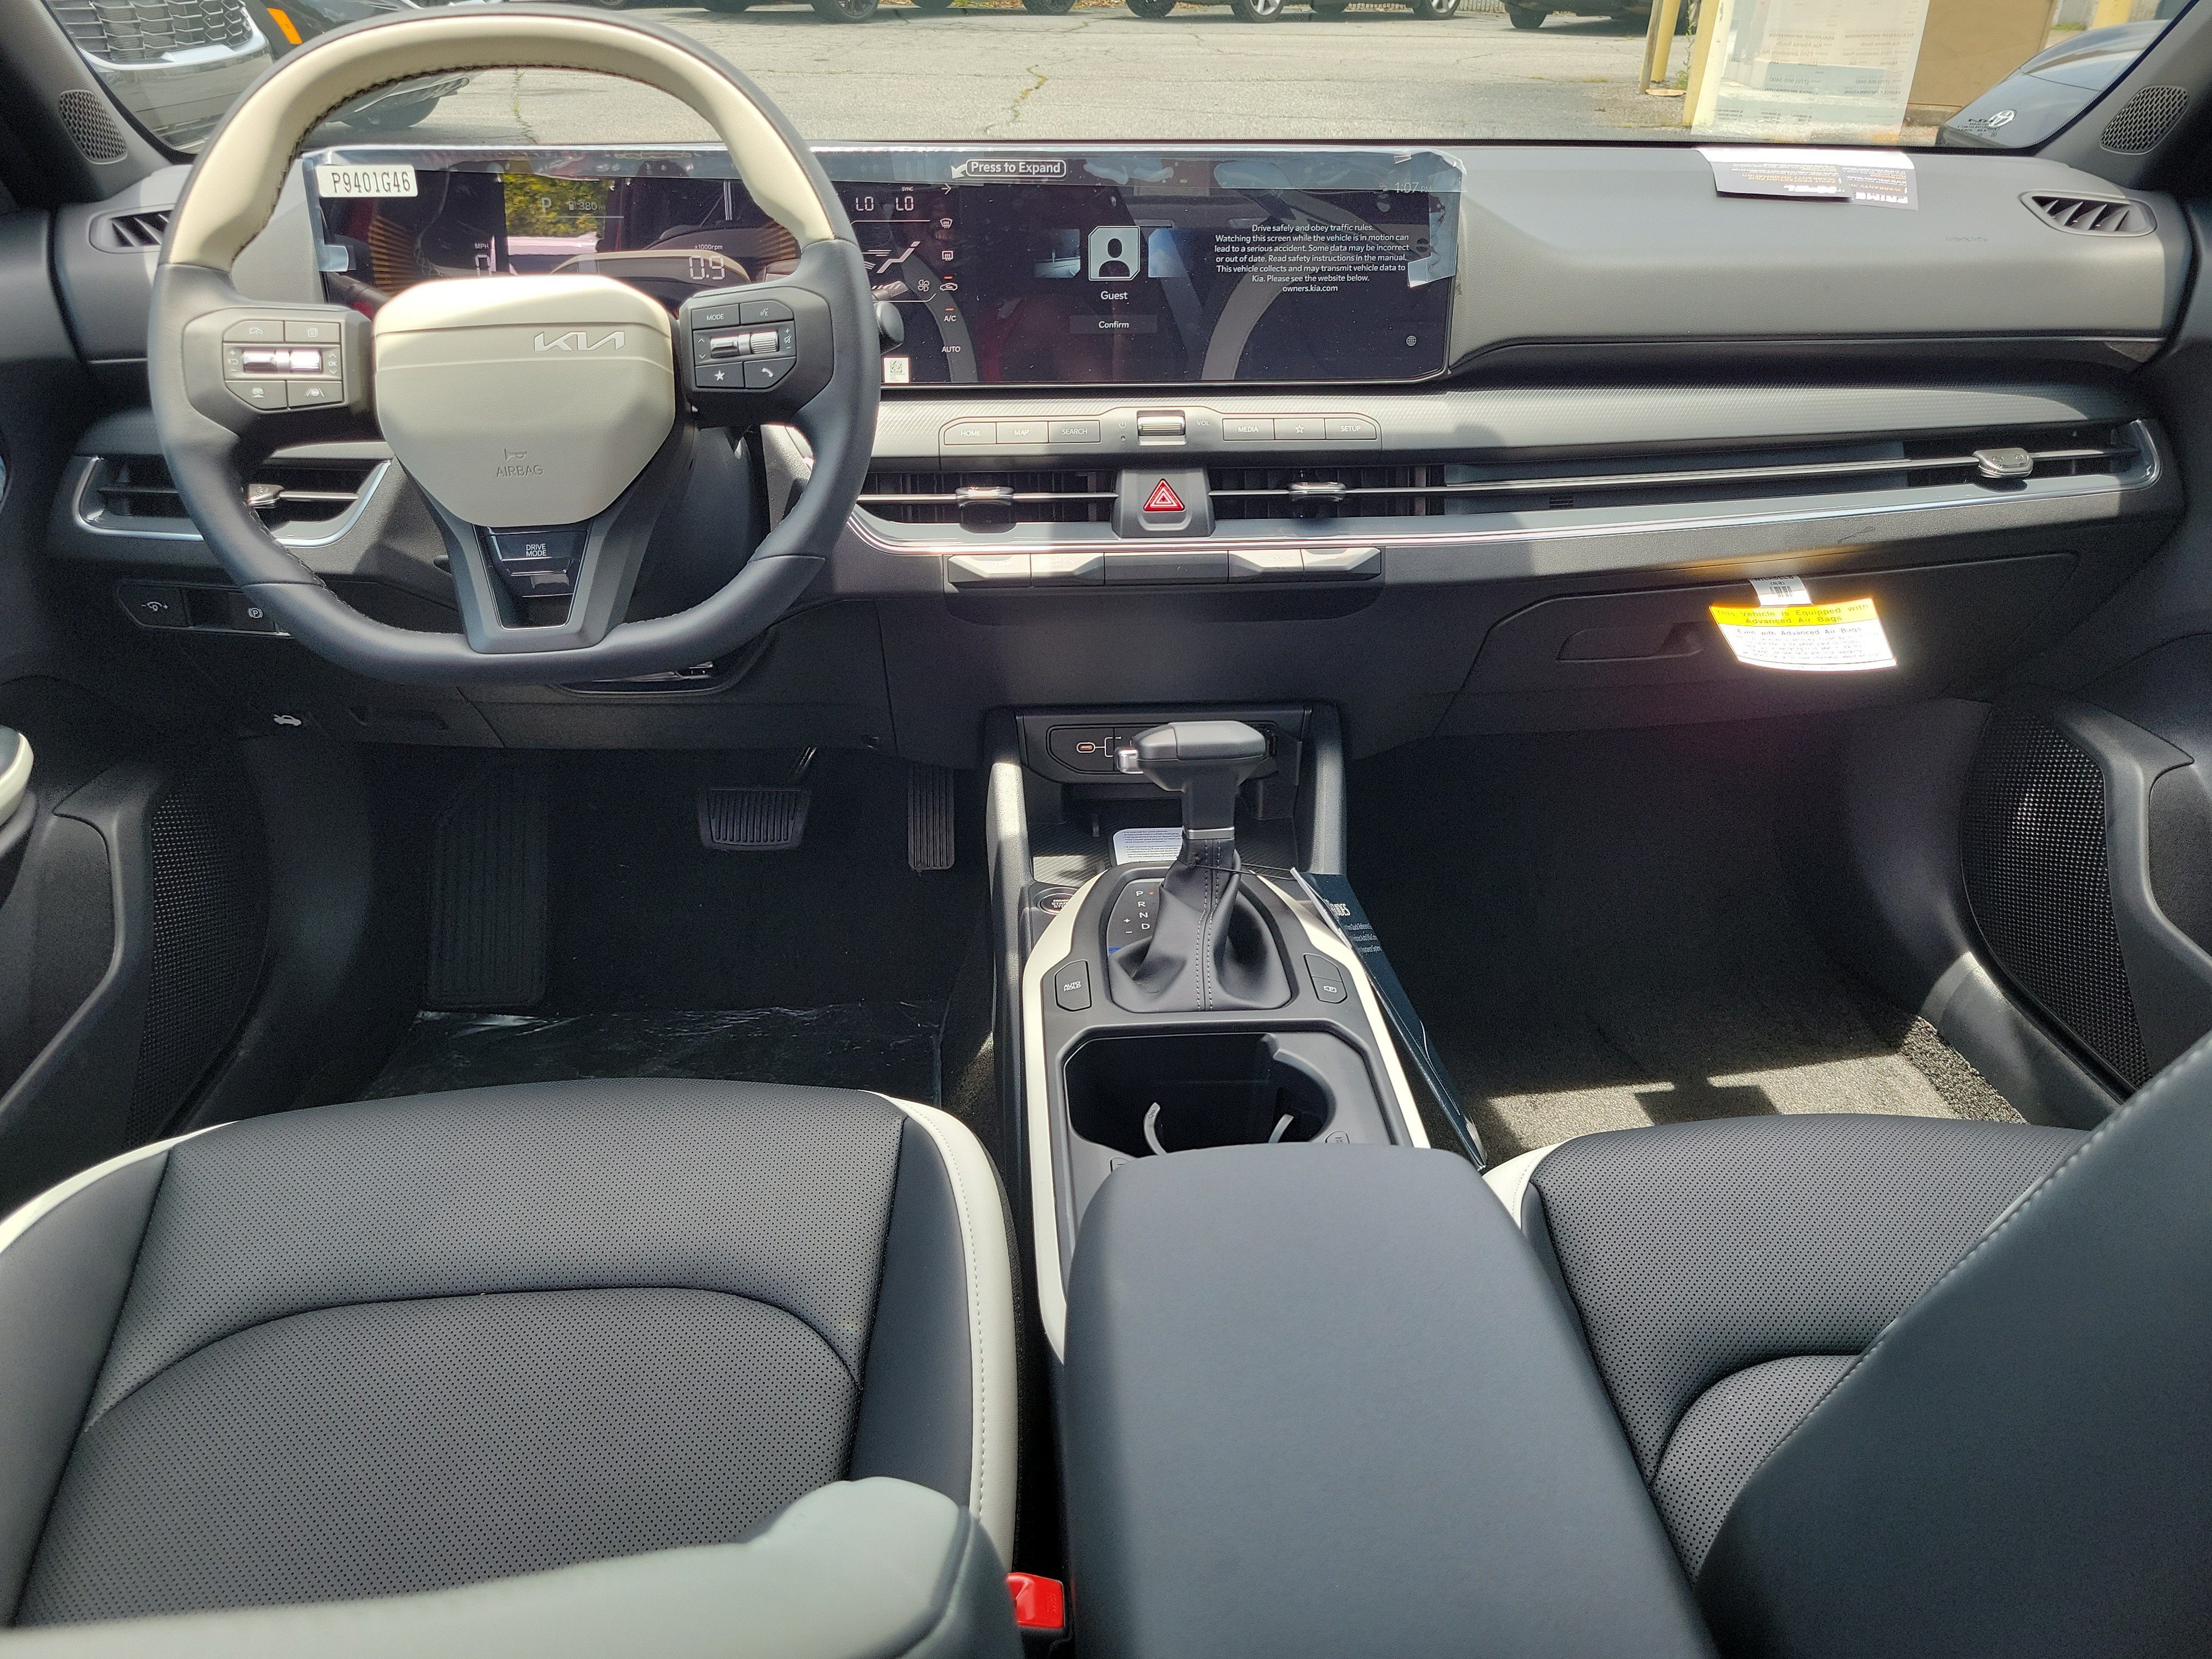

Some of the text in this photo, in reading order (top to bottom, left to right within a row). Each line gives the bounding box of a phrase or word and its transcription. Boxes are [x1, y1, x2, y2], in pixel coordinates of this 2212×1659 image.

[970, 161, 1060, 175] Press to Expand
[331, 171, 411, 195] P9401G46
[1394, 182, 1419, 194] 1:07
[1252, 223, 1374, 234] Drive safely and obey traffic rules.
[1215, 234, 1251, 244] Watching
[1252, 234, 1266, 242] this
[1292, 234, 1312, 242] while
[1313, 234, 1325, 242] the
[1326, 234, 1352, 242] vehicle
[1353, 234, 1359, 242] is
[1360, 234, 1368, 242] in
[1368, 234, 1394, 242] motion
[1214, 245, 1231, 253] lead
[1231, 245, 1240, 253] to
[1246, 245, 1273, 253] serious
[1274, 244, 1307, 252] accident.
[1308, 244, 1329, 252] Some
[1329, 244, 1347, 252] data
[1347, 246, 1365, 254] may
[1365, 244, 1375, 252] be
[1376, 244, 1410, 252] incorrect
[1224, 255, 1239, 263] out
[1239, 255, 1248, 263] of
[1248, 255, 1267, 263] date.
[1268, 255, 1287, 263] Read
[1288, 255, 1311, 264] safety
[1312, 254, 1355, 262] instructions
[1356, 254, 1363, 262] in
[1363, 254, 1376, 262] the
[1377, 254, 1407, 262] manual.
[689, 255, 725, 280] 0.9
[1216, 264, 1406, 274] This vehicle collects and may transmit vehicle data to
[1252, 275, 1266, 283] Kia.
[1267, 274, 1290, 283] Please
[1304, 274, 1317, 283] the
[1318, 274, 1346, 283] website
[1346, 274, 1370, 283] below.
[1282, 284, 1338, 292] owners.kia.com
[1100, 290, 1128, 301] Guest
[706, 313, 725, 321] MODE
[943, 314, 957, 323] A/C
[1098, 320, 1130, 329] Confirm
[941, 345, 961, 353] AUTO
[1237, 425, 1259, 433] MEDIA
[496, 464, 544, 477] AIRBAG
[1795, 607, 1841, 616] Equipped
[1847, 603, 1869, 612] with
[1063, 984, 1081, 992] HOLD
